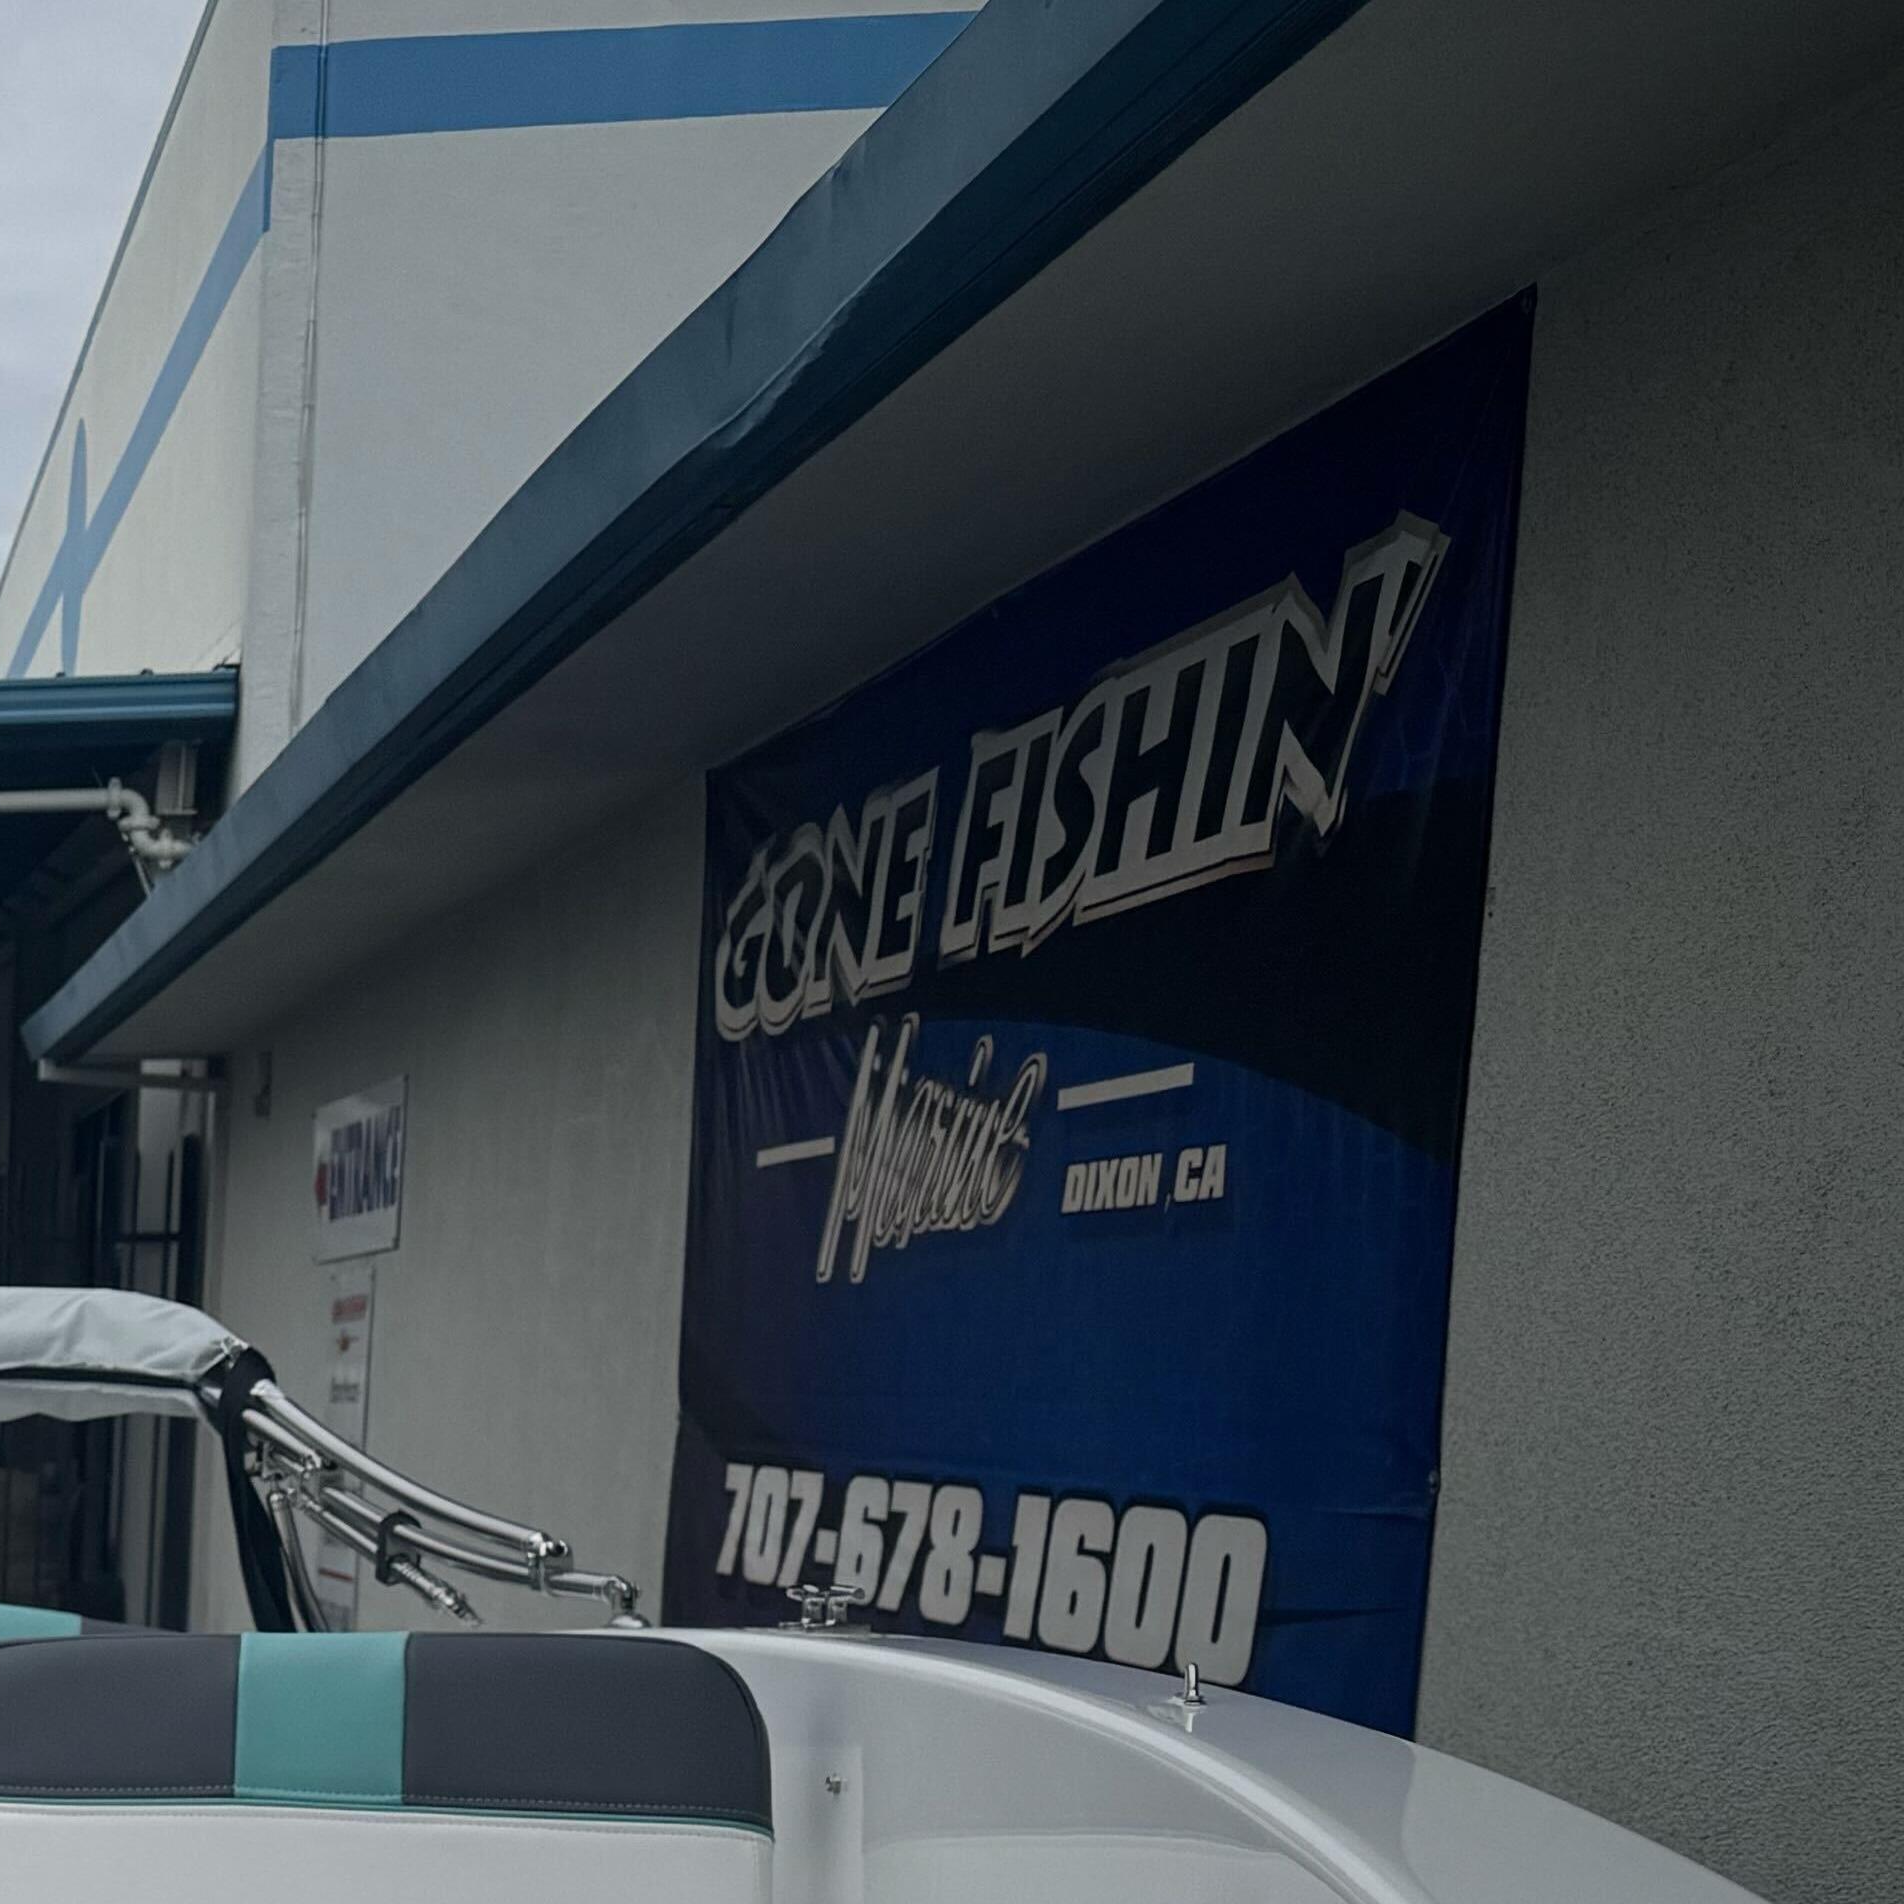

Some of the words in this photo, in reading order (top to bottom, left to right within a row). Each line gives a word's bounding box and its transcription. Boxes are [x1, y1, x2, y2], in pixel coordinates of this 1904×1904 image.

[715, 767, 940, 1041] GONE
[816, 1011, 1048, 1284] Marine
[1174, 1144, 1228, 1204] CA
[716, 1462, 1268, 1687] 707-678-1600
